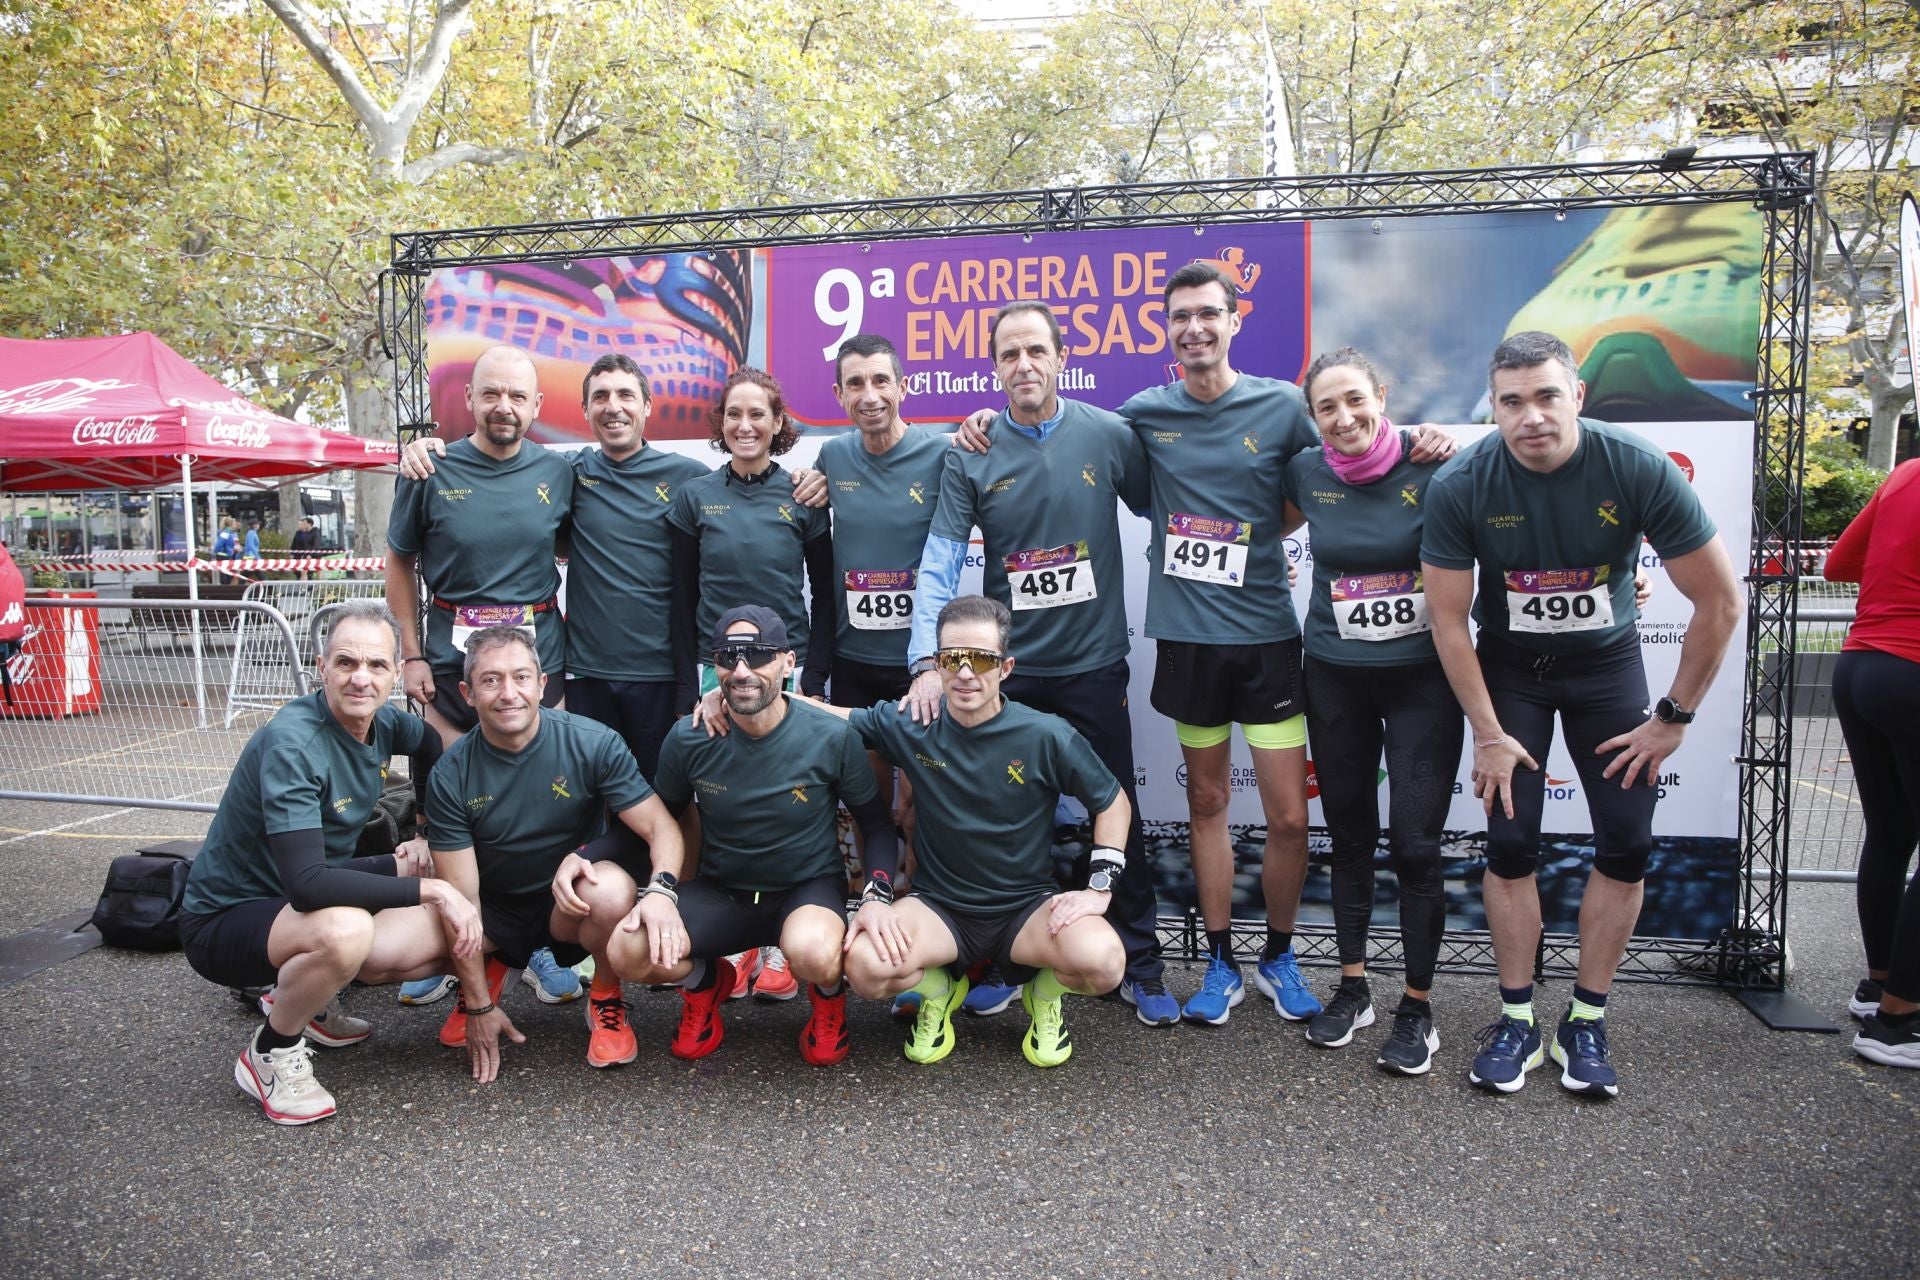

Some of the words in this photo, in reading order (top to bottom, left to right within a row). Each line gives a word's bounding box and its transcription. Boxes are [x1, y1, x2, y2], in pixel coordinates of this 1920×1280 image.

[906, 254, 1099, 304] CARRERA
[1114, 252, 1167, 297] DE
[906, 302, 1166, 360] EMPSAS
[907, 371, 932, 396] El
[934, 371, 987, 394] Norte
[988, 370, 1002, 393] d
[1312, 490, 1345, 499] GUARDIA
[1487, 515, 1525, 524] GUARDIA
[1191, 523, 1222, 534] EMPRESAS
[1174, 540, 1229, 571] 491
[1020, 566, 1077, 597] 487
[1363, 581, 1397, 591] EMPRESAS
[1538, 577, 1577, 586] EMPRESAS
[856, 594, 912, 617] 489
[1522, 594, 1596, 621] 490
[1347, 598, 1416, 628] 488
[1636, 622, 1674, 630] tamiento
[1676, 622, 1687, 630] de
[916, 753, 947, 768] GUARDIA
[1242, 768, 1255, 777] DE
[696, 779, 728, 791] GUARDIA
[702, 786, 719, 795] CIVIL
